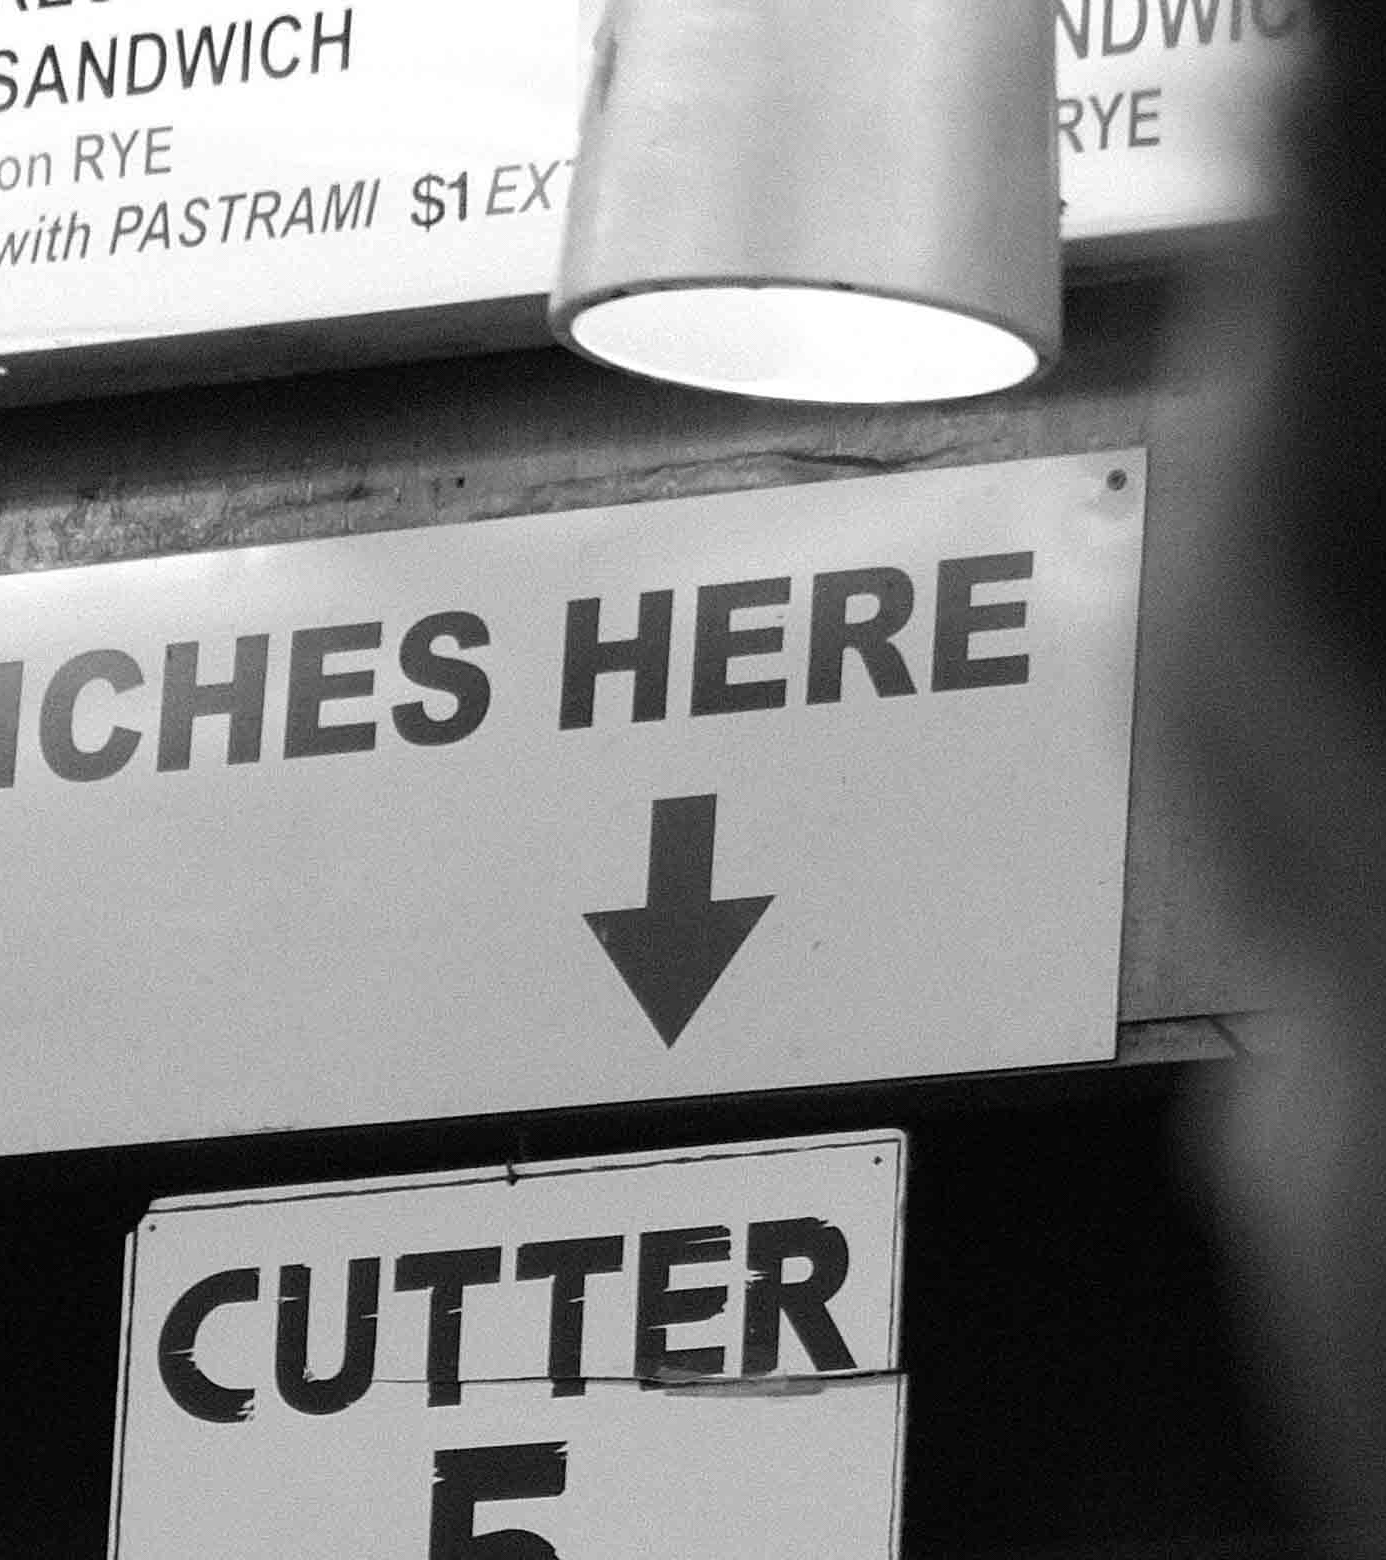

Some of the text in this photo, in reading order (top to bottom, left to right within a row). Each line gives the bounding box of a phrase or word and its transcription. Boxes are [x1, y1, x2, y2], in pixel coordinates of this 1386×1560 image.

[73, 125, 175, 185] RYE
[1057, 88, 1162, 153] RYE
[109, 178, 382, 257] PASTRAMI
[410, 170, 470, 232] $1
[485, 156, 577, 219] EX
[559, 549, 1035, 731] HERE
[157, 1215, 860, 1424] CUTTER
